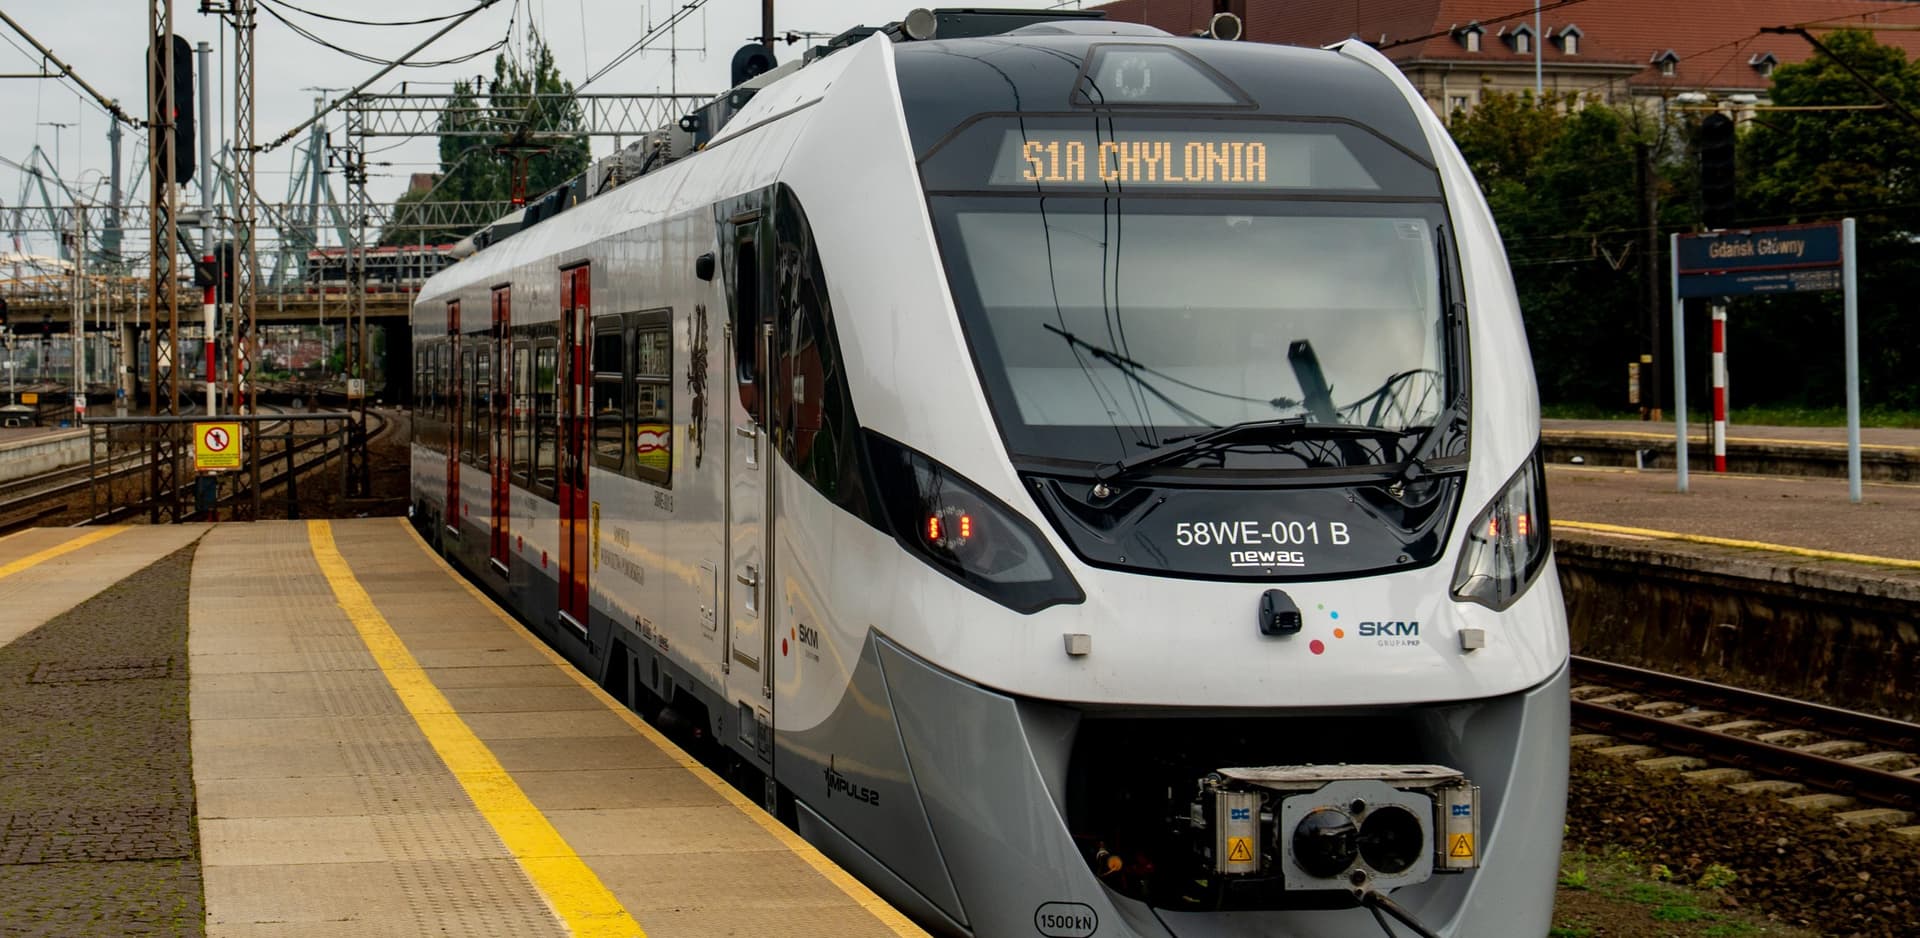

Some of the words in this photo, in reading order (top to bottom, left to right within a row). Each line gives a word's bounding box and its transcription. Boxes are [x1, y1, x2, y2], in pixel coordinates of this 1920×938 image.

[1023, 141, 1085, 182] S1A
[1099, 142, 1266, 182] CHYLONIA
[1709, 240, 1754, 258] Gdańsk
[1758, 237, 1805, 257] Główny
[1176, 521, 1319, 546] 58WE-001
[1331, 522, 1350, 545] B
[1230, 551, 1305, 566] newag
[798, 624, 818, 650] SKM
[1359, 621, 1419, 636] SKM
